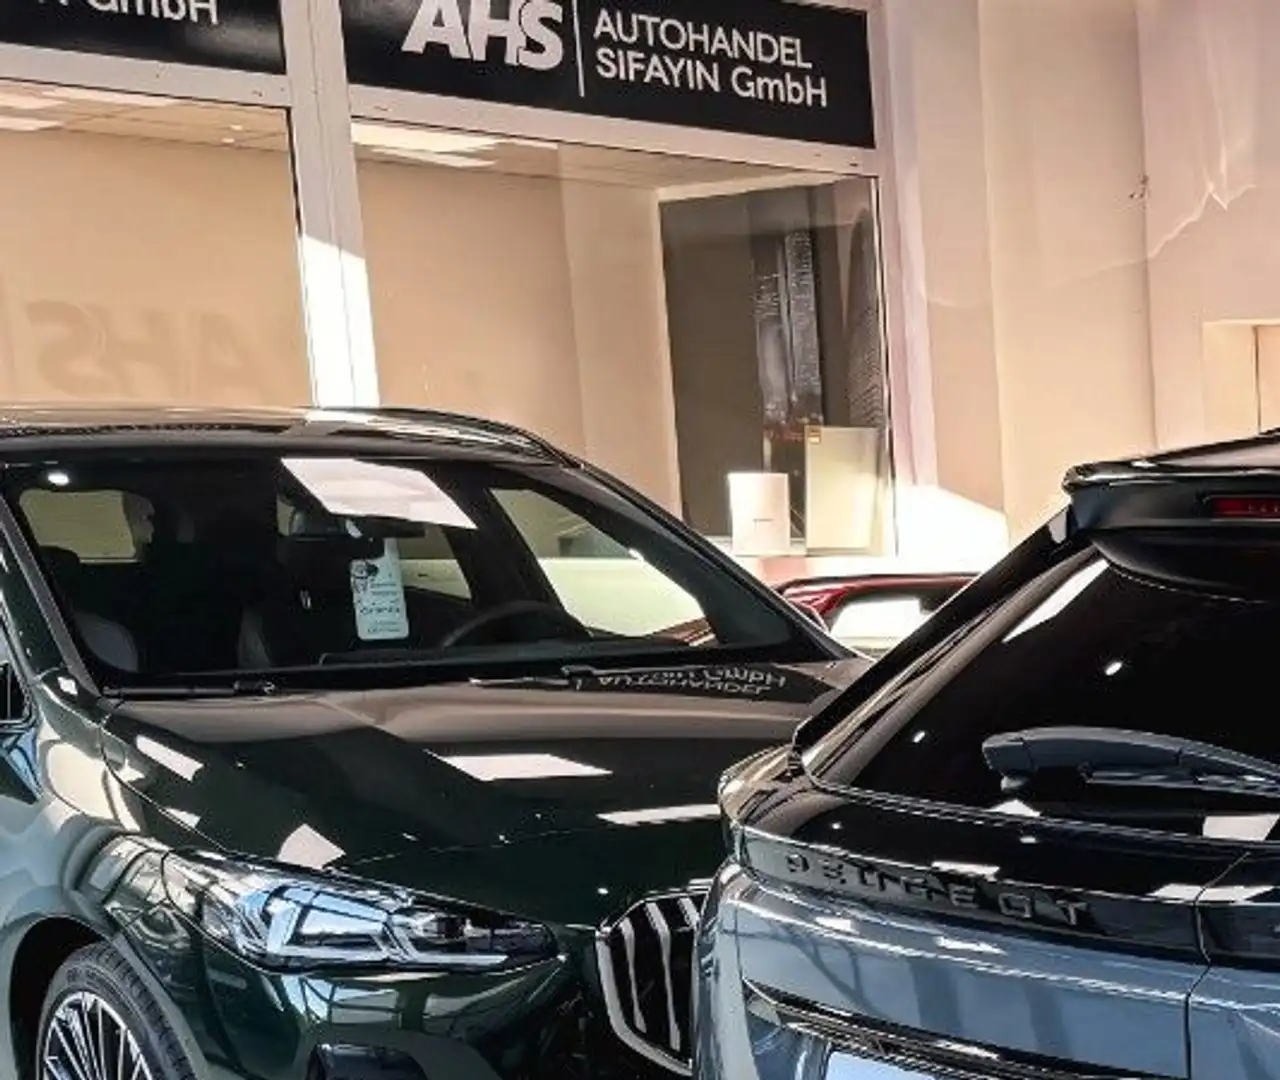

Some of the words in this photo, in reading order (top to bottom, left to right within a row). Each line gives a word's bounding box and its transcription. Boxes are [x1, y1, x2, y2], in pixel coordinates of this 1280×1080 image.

[401, 0, 564, 71] AHS
[592, 8, 813, 69] AUTOHANDEL
[596, 47, 720, 93] SIFAYIN
[731, 70, 827, 107] GmbH
